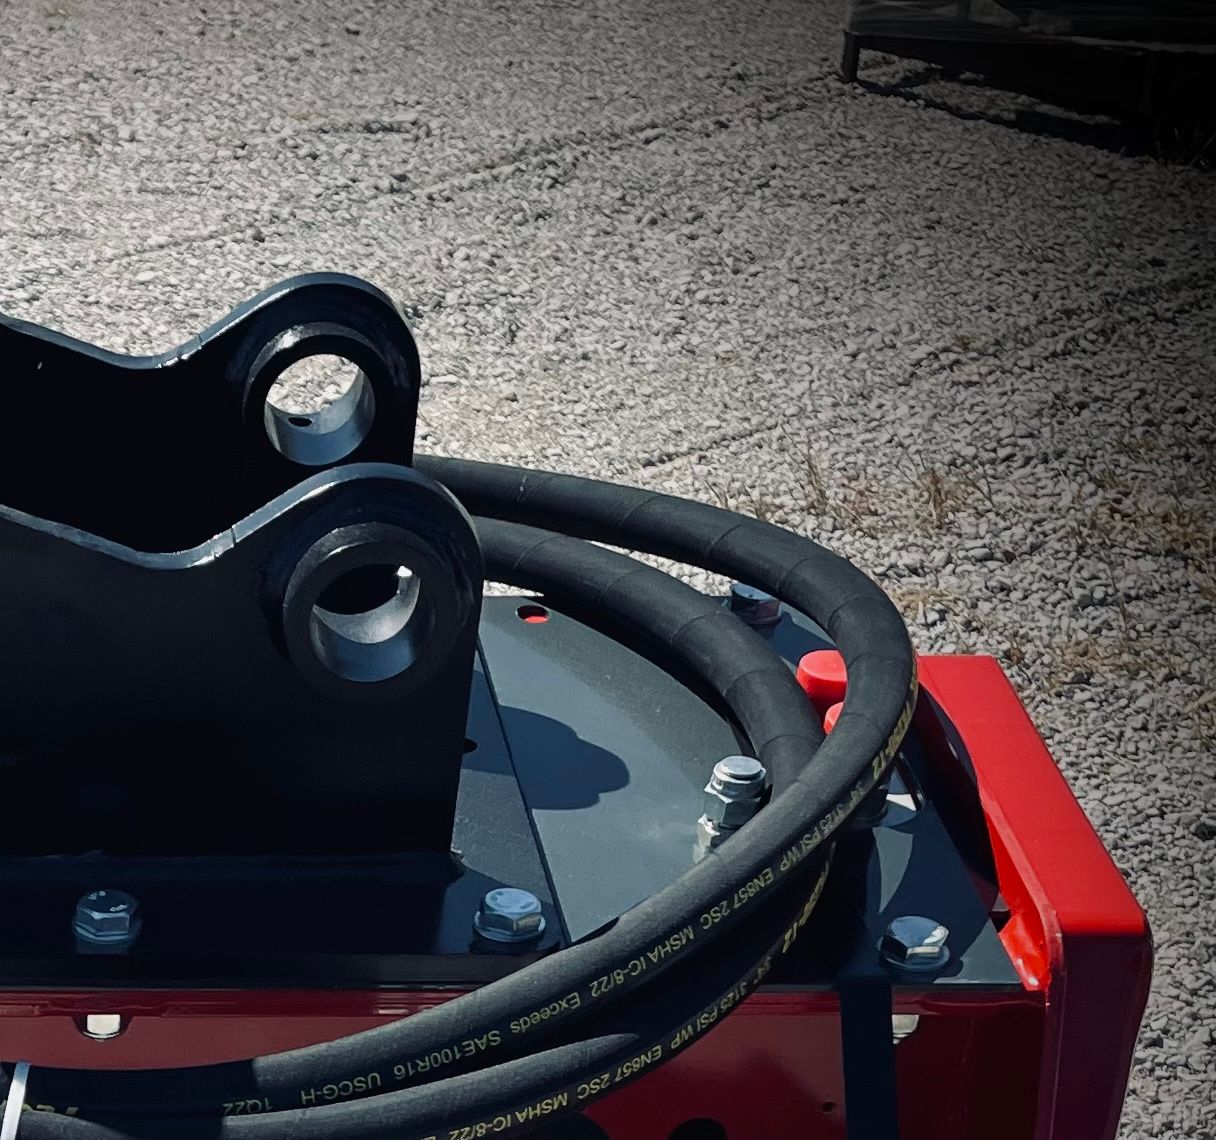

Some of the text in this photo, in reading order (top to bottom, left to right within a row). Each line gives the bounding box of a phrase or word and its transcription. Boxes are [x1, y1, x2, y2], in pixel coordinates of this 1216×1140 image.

[734, 867, 775, 910] EN857
[699, 898, 731, 930] 2SC
[646, 924, 695, 963] MSHA
[588, 960, 647, 998] IC-8/22
[509, 991, 582, 1034] Exceeds
[392, 1029, 502, 1081] SAE100R16
[614, 1044, 663, 1082] EN857
[300, 1072, 383, 1105] USCG-H
[576, 1071, 611, 1101] 2SC
[515, 1091, 569, 1124] MSHA
